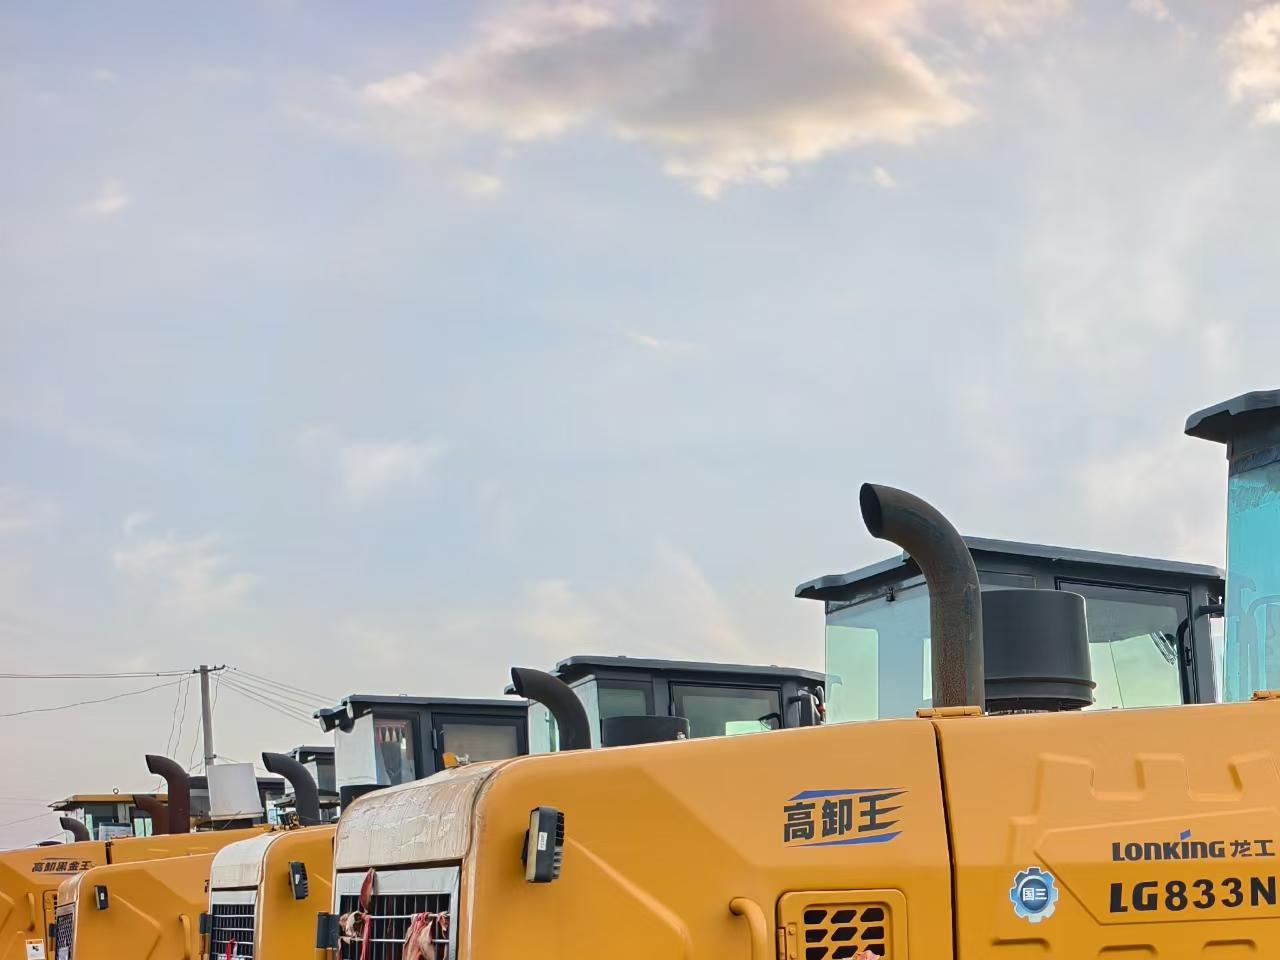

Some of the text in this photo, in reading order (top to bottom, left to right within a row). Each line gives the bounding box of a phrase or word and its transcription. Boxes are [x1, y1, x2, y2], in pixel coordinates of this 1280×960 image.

[783, 790, 909, 842] 高卸王
[1229, 839, 1276, 858] 龙工
[1109, 875, 1277, 913] LG833N
